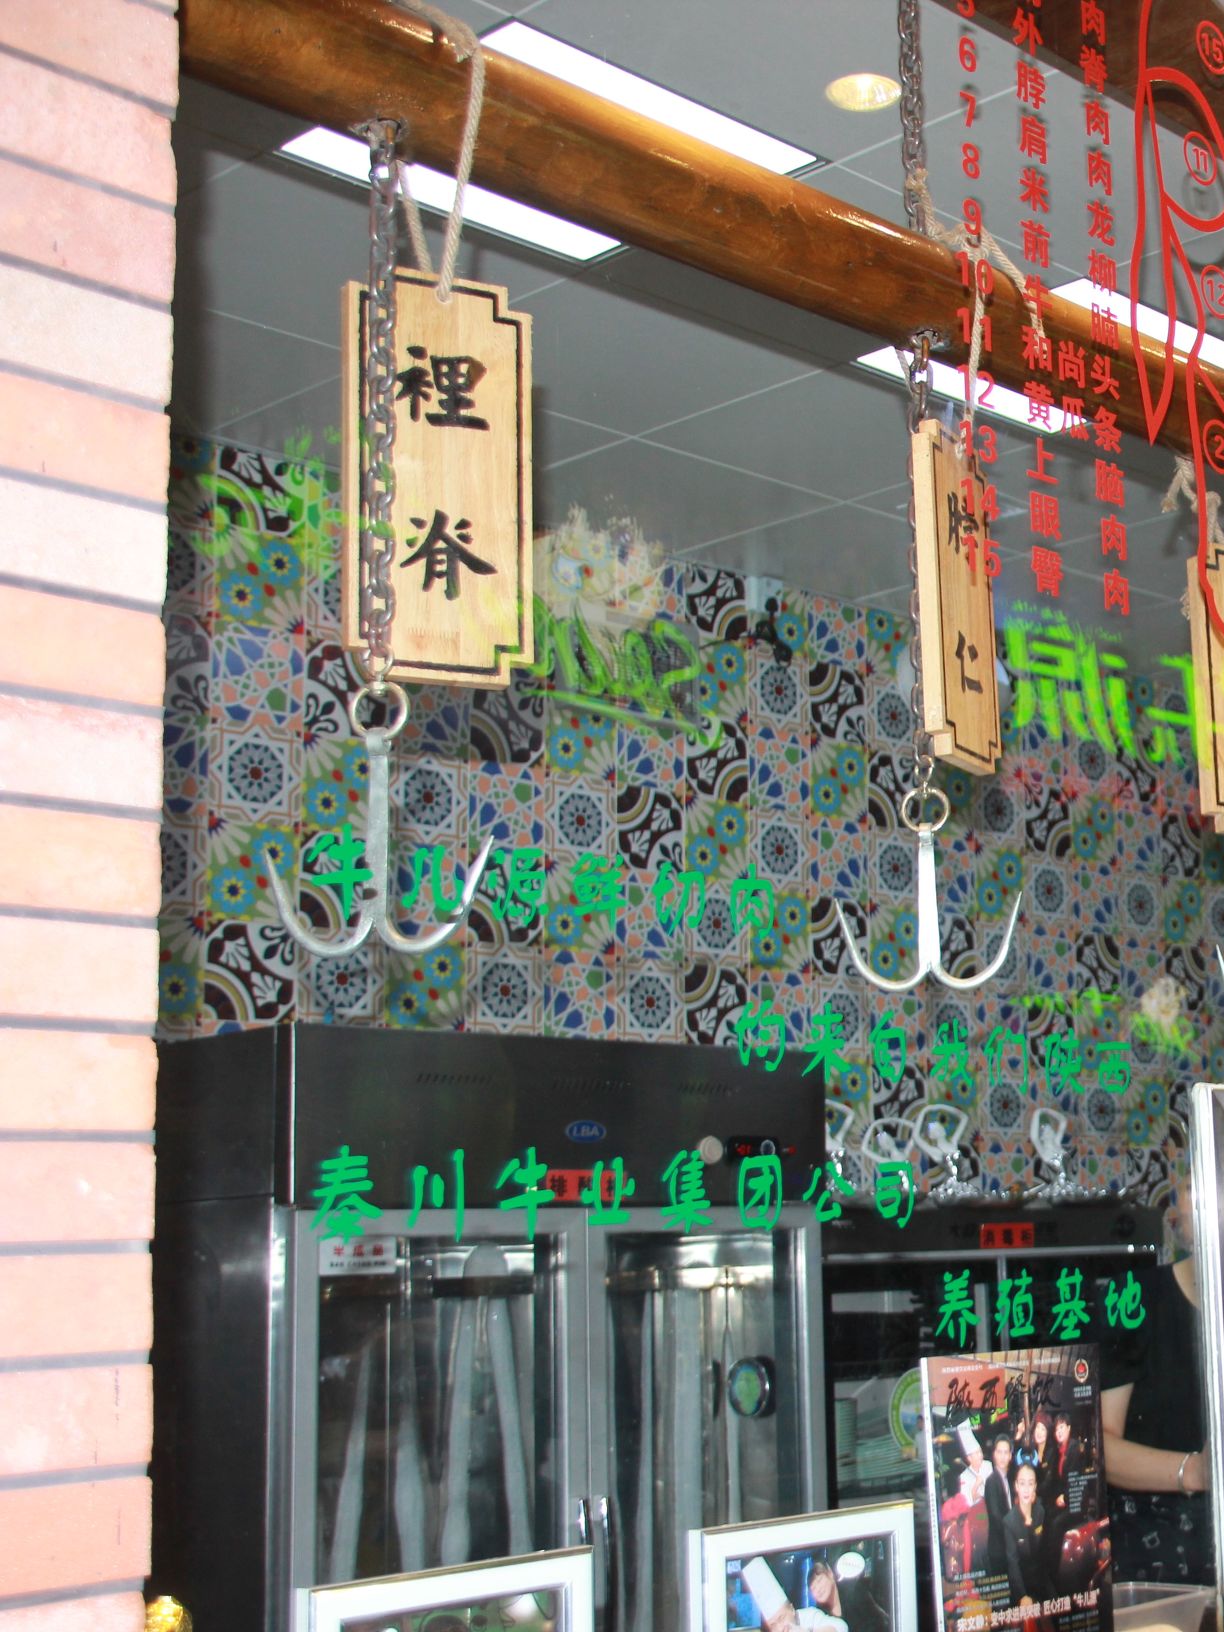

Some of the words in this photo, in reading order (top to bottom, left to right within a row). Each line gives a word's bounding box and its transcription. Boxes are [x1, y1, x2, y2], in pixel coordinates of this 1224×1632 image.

[958, 36, 977, 73] 6
[959, 91, 977, 128] 7
[961, 142, 981, 180] 8
[962, 197, 982, 236] 9
[955, 251, 994, 295] 10
[957, 307, 992, 352] 11
[957, 364, 995, 410] 12
[959, 420, 997, 464] 13
[961, 477, 1000, 522] 14
[961, 534, 1002, 579] 15
[310, 1145, 914, 1244] 秦川牛业集团公司
[936, 1268, 1146, 1348] 养殖基地
